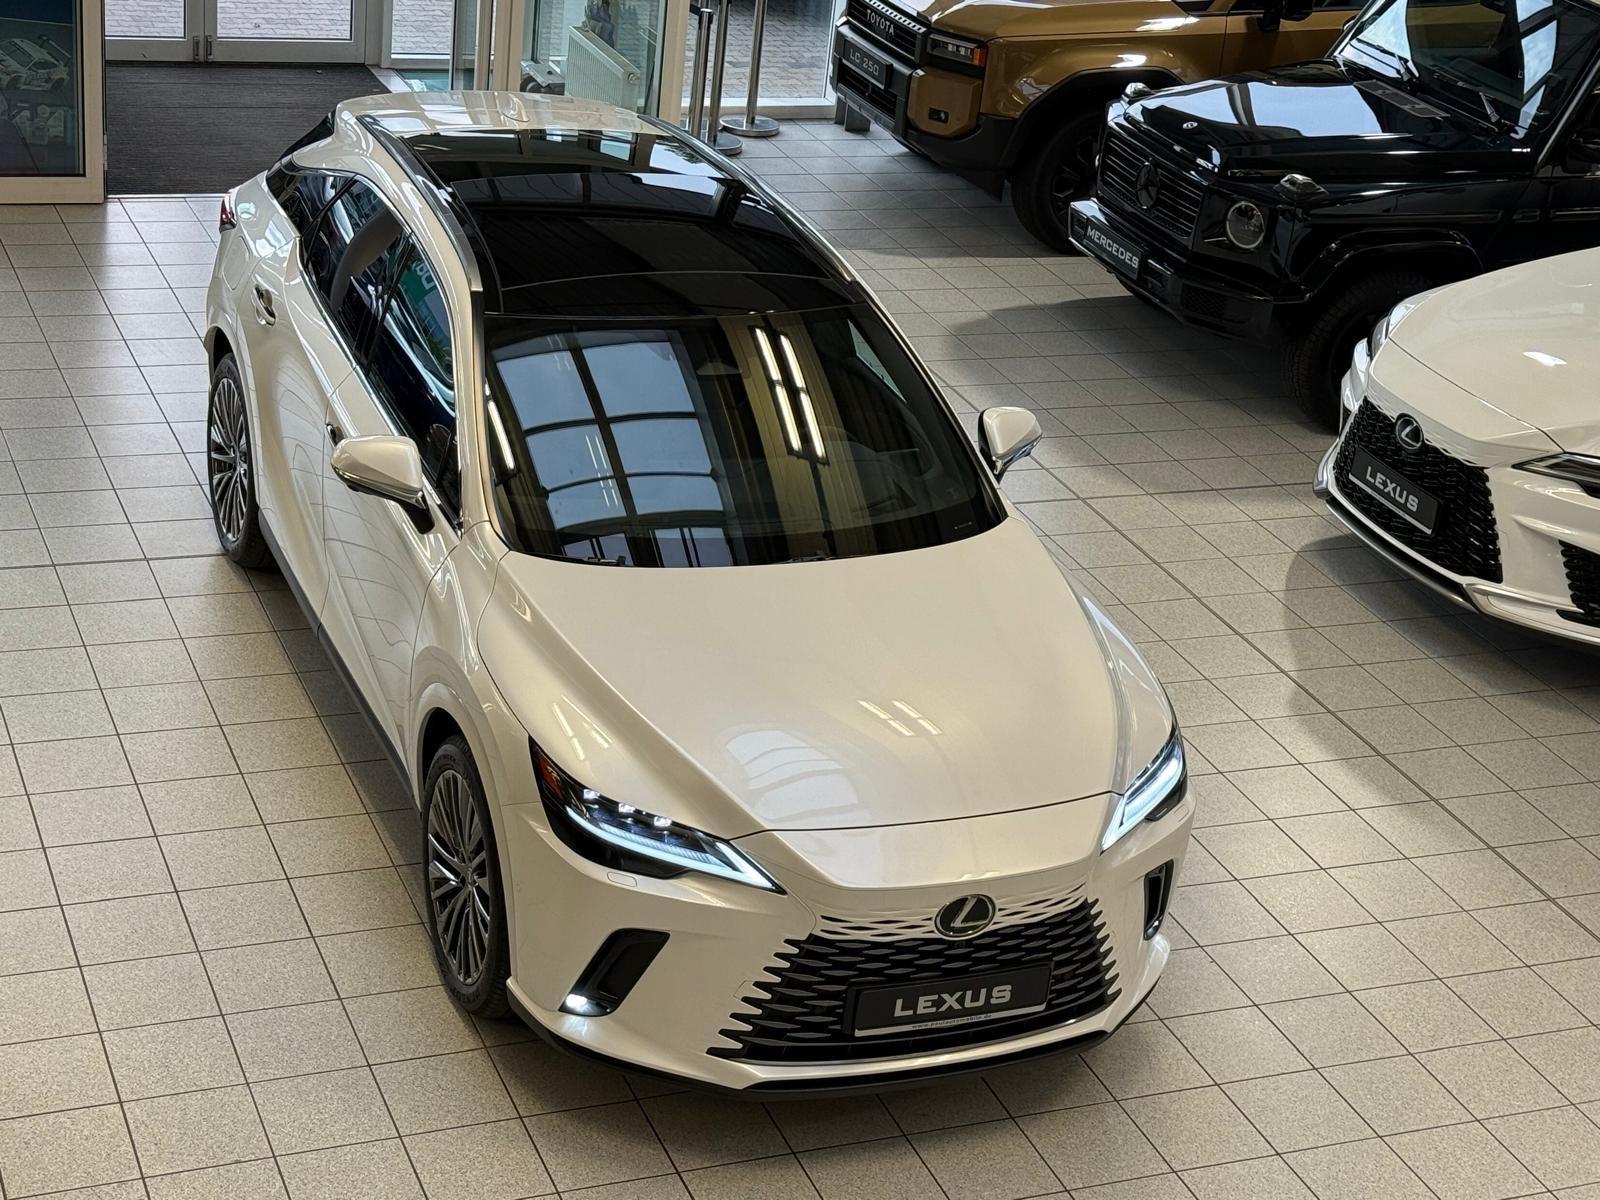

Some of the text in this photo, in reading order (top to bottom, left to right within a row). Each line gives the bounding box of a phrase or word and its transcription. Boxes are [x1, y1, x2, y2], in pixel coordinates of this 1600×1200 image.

[866, 9, 895, 36] TOYOTA
[849, 48, 879, 76] LC 250
[1087, 225, 1139, 269] MERCEDES
[1365, 465, 1419, 512] LEXUS
[894, 984, 1013, 1017] LEXUS
